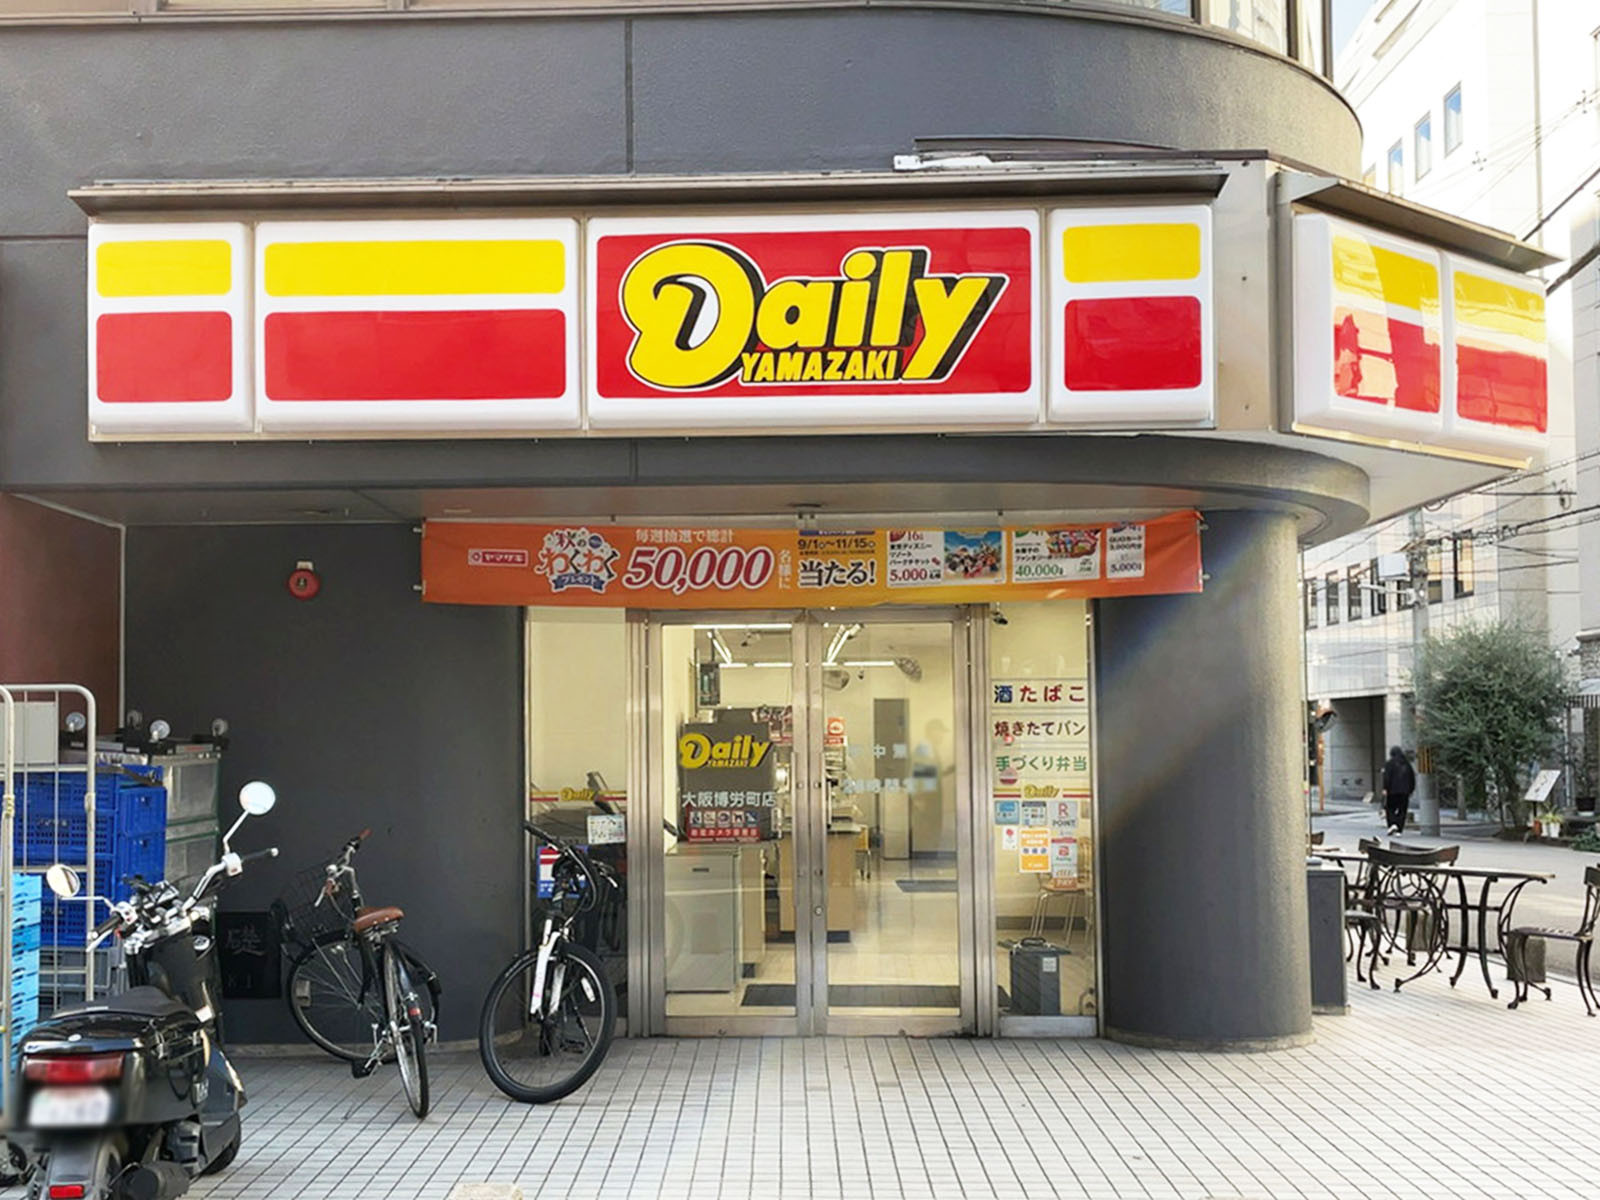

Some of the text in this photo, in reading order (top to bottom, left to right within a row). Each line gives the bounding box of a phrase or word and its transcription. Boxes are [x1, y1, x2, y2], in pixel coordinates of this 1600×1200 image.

[619, 240, 1009, 392] Daily
[740, 349, 899, 383] YAMAZAKI
[635, 529, 734, 543] 毎週抽選で総計
[536, 549, 619, 579] わくわく
[623, 546, 775, 595] 50,000
[680, 732, 772, 769] Daily
[995, 755, 1087, 772] 手づくり弁当
[682, 791, 777, 807] 大阪博労町店
[1024, 784, 1060, 799] Daily
